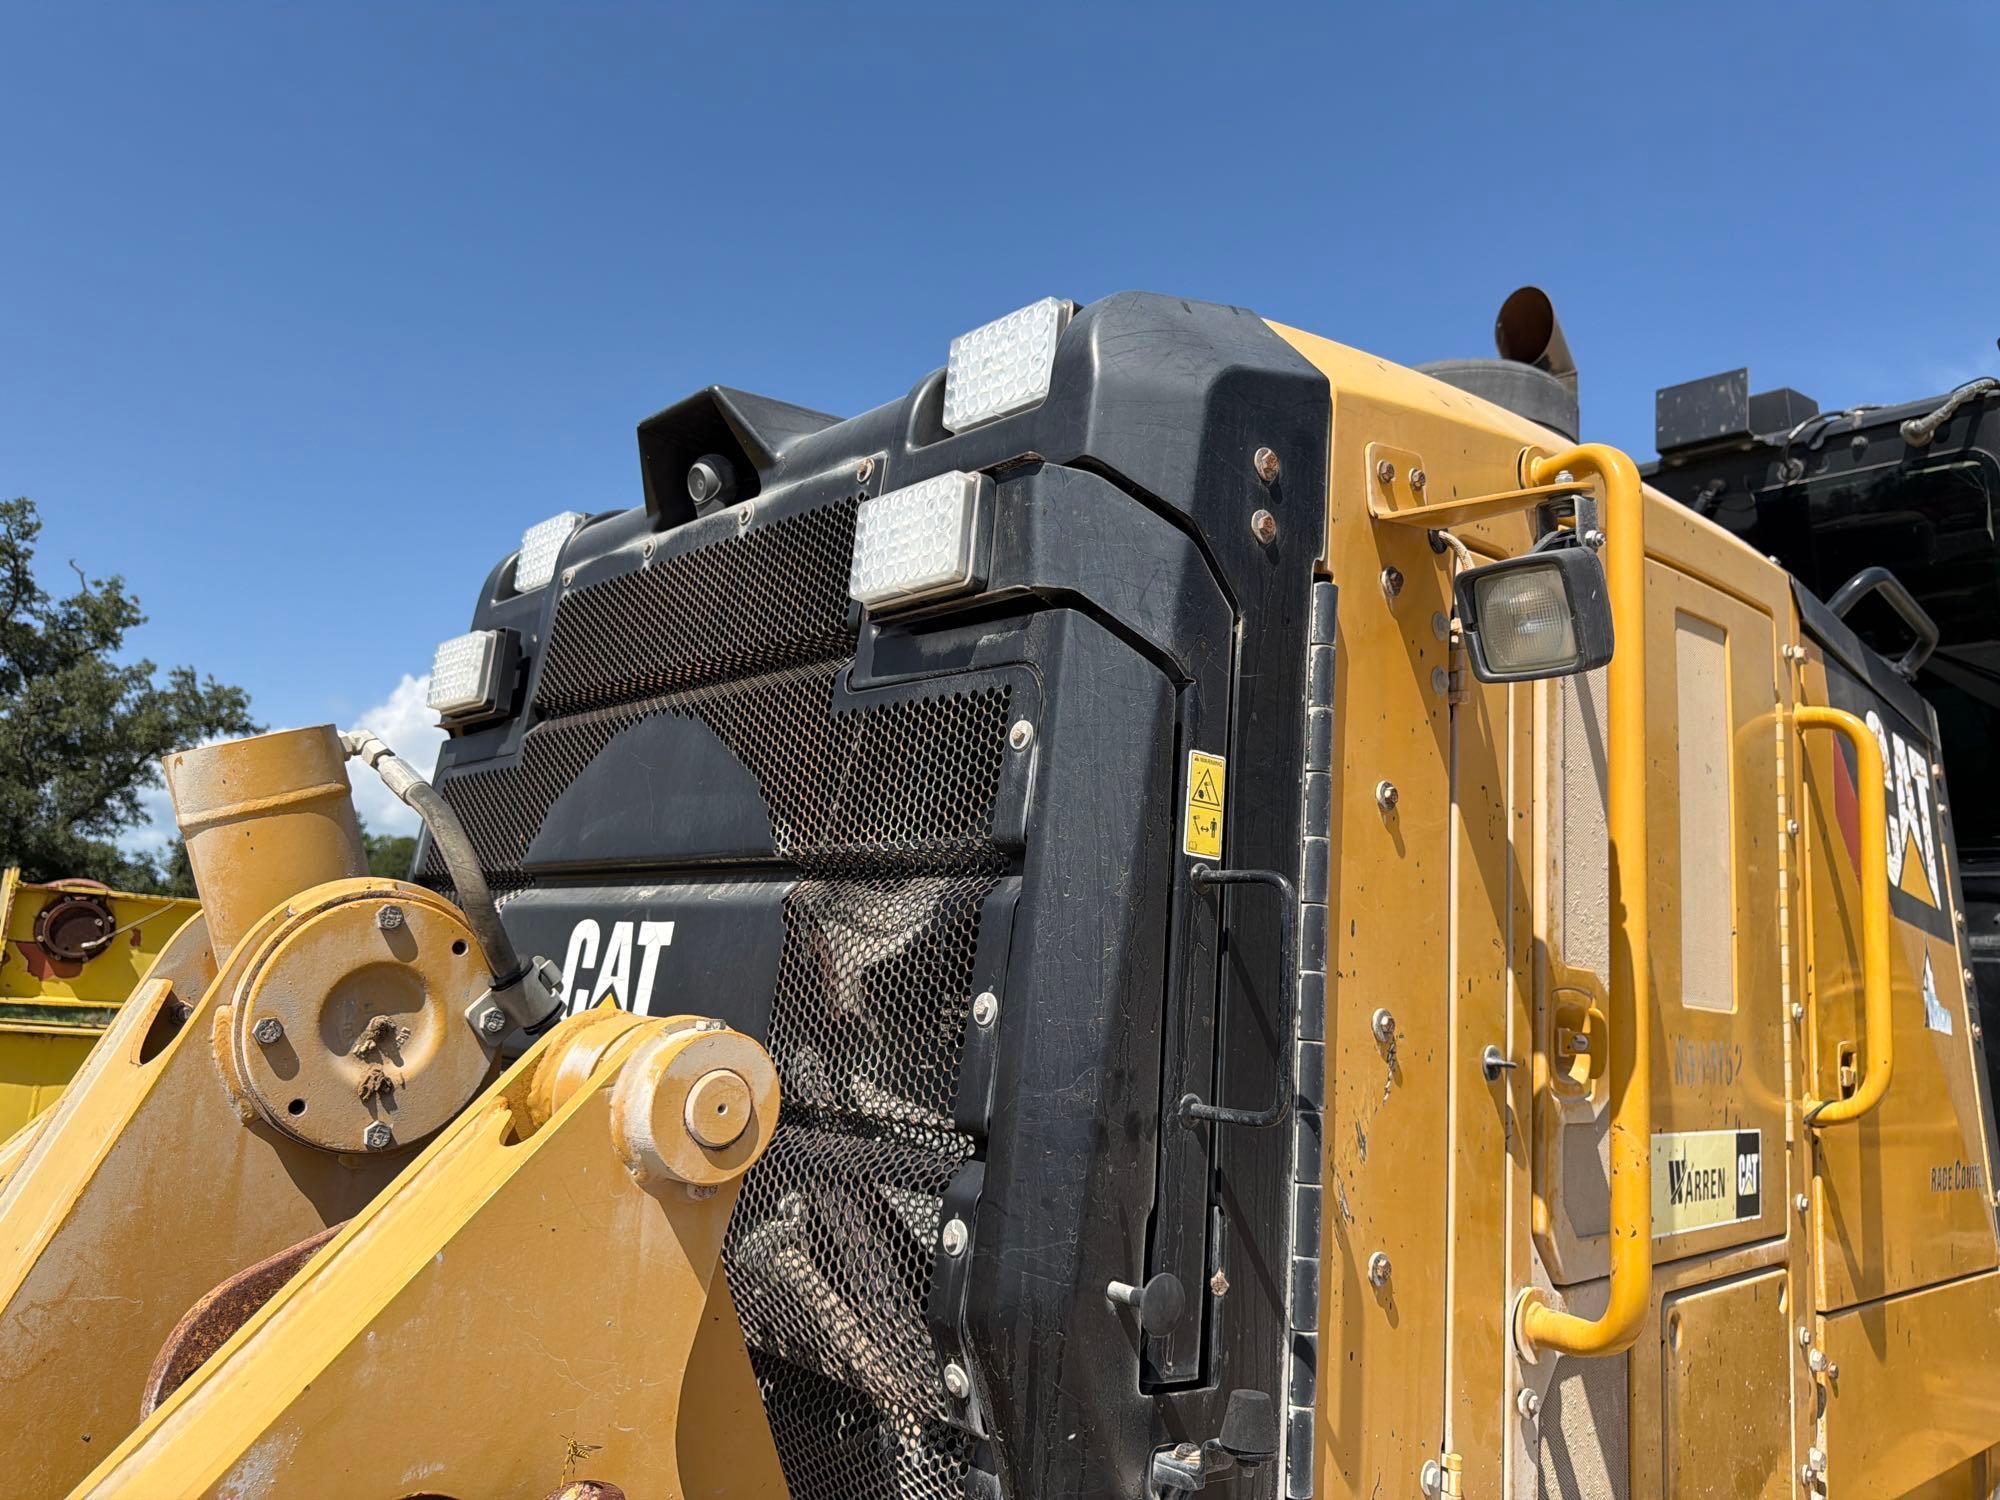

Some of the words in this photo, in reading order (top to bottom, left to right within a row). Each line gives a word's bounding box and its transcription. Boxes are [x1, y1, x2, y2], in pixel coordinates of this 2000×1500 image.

[1866, 710, 1941, 911] CAT
[560, 918, 675, 1021] CAT
[1668, 1159, 1725, 1205] WARREN
[1738, 1153, 1759, 1196] CAT
